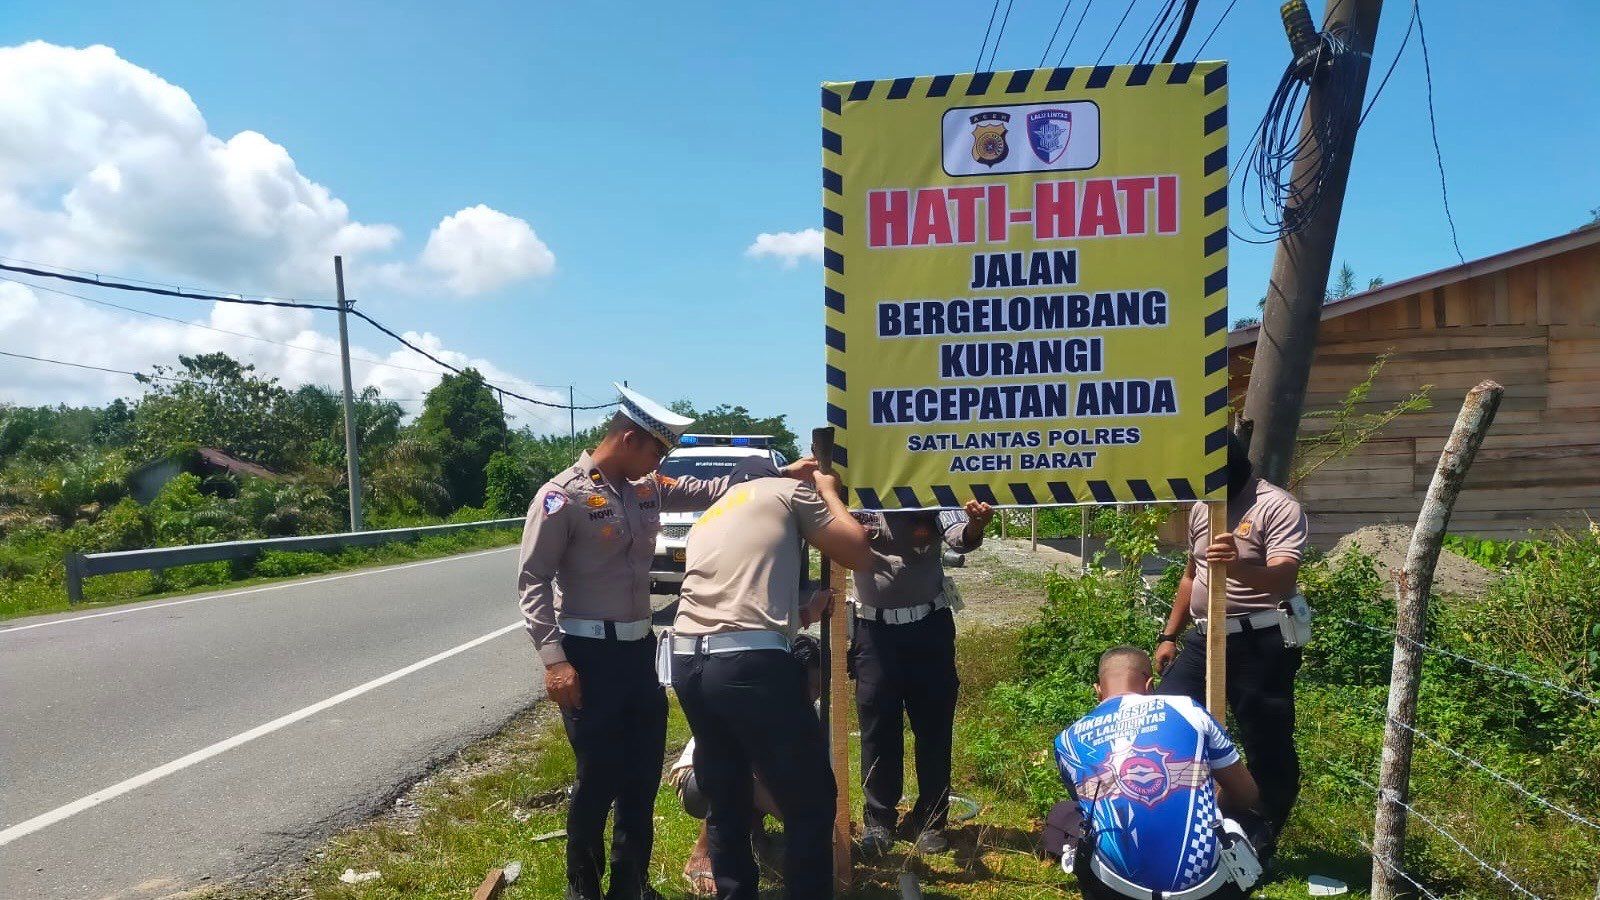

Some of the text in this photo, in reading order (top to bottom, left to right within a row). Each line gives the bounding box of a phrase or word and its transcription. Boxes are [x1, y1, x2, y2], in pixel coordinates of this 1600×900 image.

[973, 113, 1007, 122] ACEH
[1048, 111, 1068, 119] LINTAS
[867, 175, 1178, 248] HATI-HATI
[971, 249, 1077, 289] JALAN
[878, 290, 1168, 337] BERGELOMBANG
[940, 337, 1102, 378] KURANGI
[871, 379, 1178, 424] KECEPATAN ANDA
[907, 428, 1140, 452] SATLANTAS POLRES
[949, 451, 1097, 472] ACEH BARAT
[588, 508, 614, 521] NOVI
